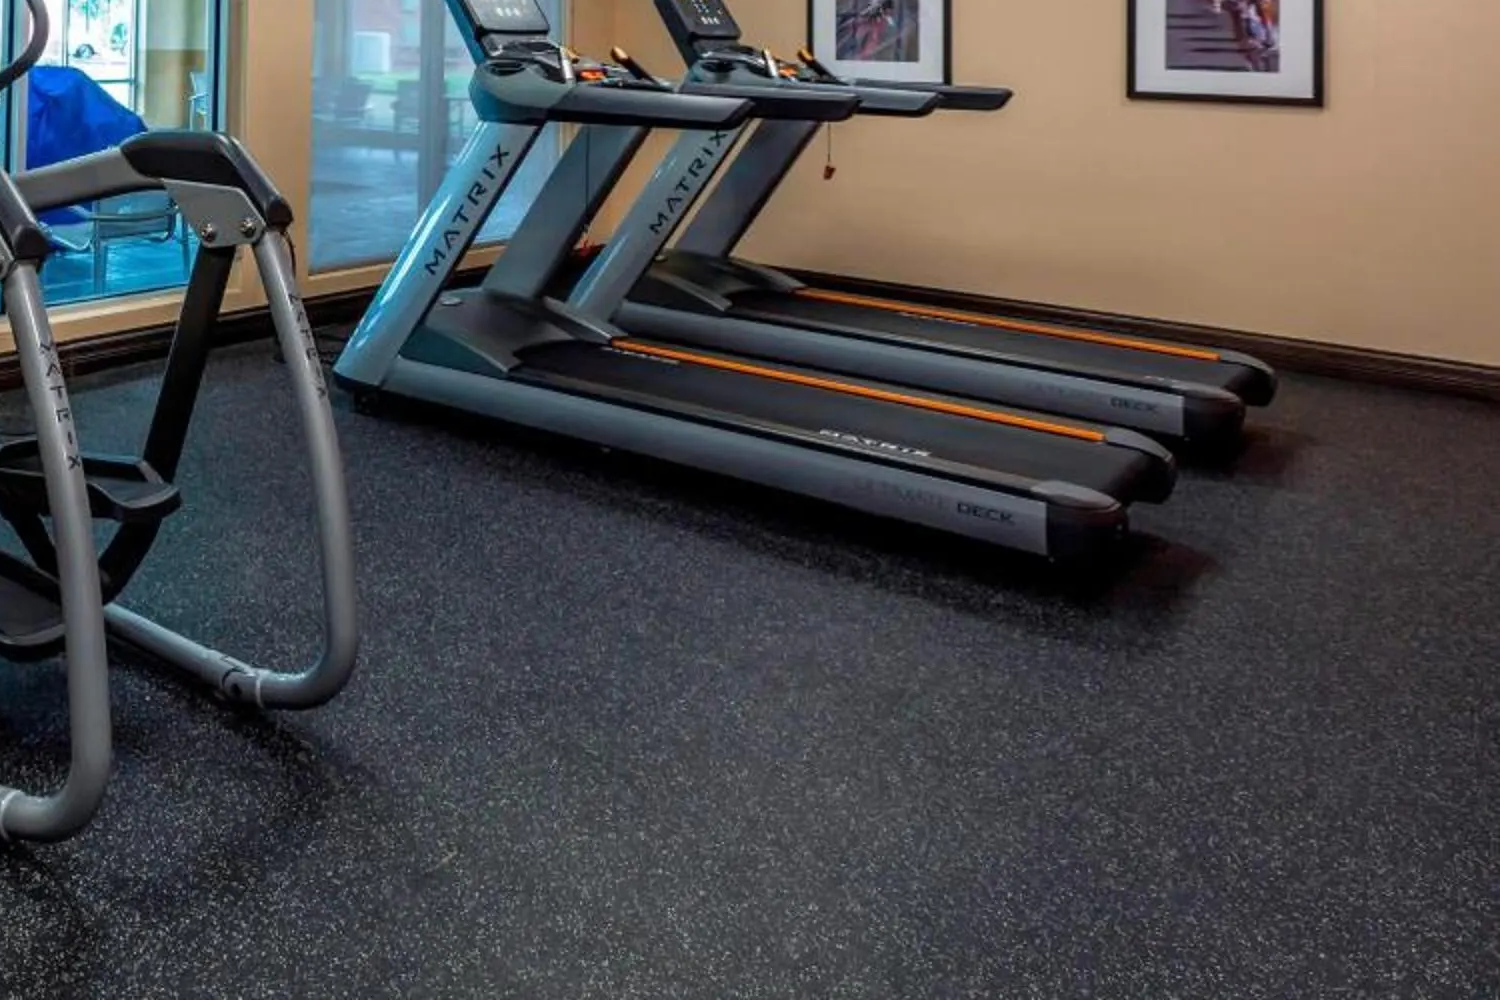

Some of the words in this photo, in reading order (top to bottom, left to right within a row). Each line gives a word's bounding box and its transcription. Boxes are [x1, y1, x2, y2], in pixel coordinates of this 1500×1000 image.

[424, 143, 510, 275] MATRIX
[650, 129, 729, 236] MATRIX
[957, 502, 1014, 525] DECK
